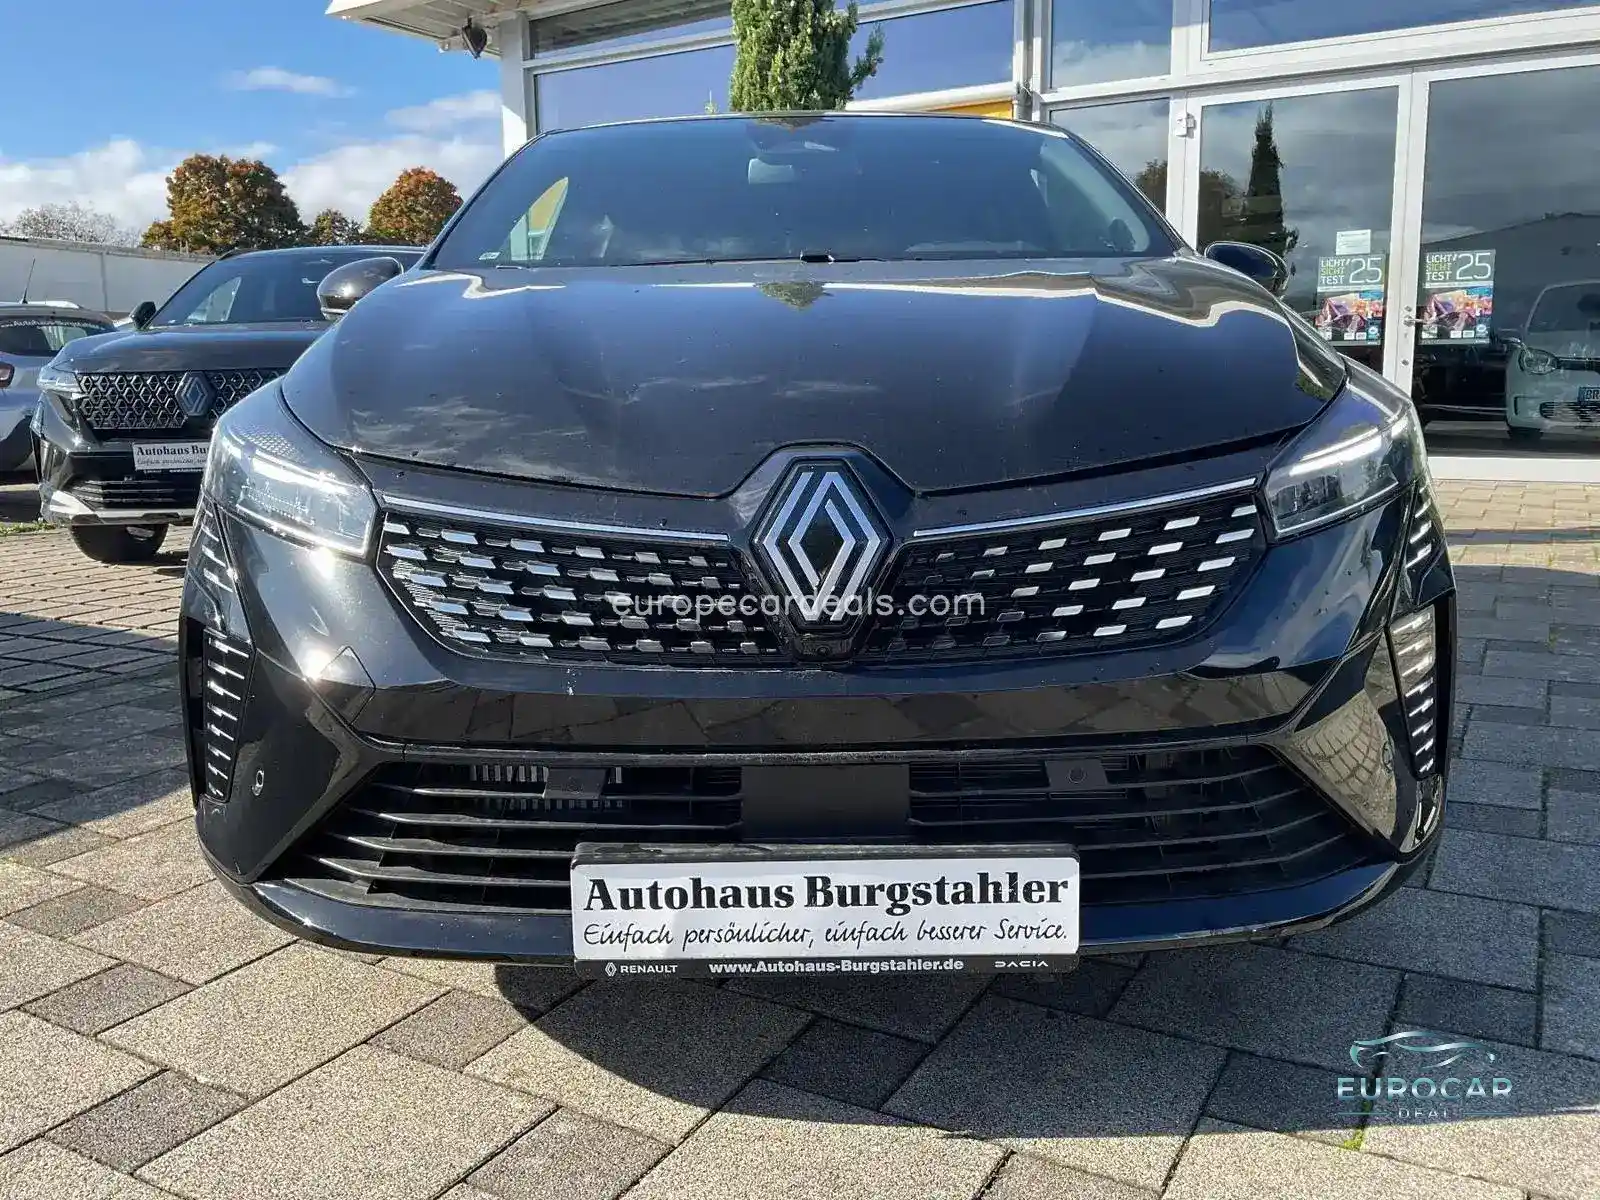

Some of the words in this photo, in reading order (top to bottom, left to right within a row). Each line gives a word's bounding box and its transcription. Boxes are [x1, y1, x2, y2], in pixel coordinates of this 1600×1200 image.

[1320, 275, 1345, 284] TEST
[1426, 271, 1452, 281] TEST
[136, 446, 189, 455] Autohaus
[583, 876, 795, 912] Autohaus
[804, 871, 1069, 916] Burgstahler
[583, 921, 673, 946] Einfach
[682, 918, 815, 952] persönlicher,
[825, 919, 908, 944] einfach
[917, 918, 987, 942] besserer
[995, 917, 1068, 940] Service.
[620, 964, 678, 974] RENAULT
[708, 958, 965, 973] www.Autohaus-Burgstahler.de
[994, 960, 1049, 968] DACIA
